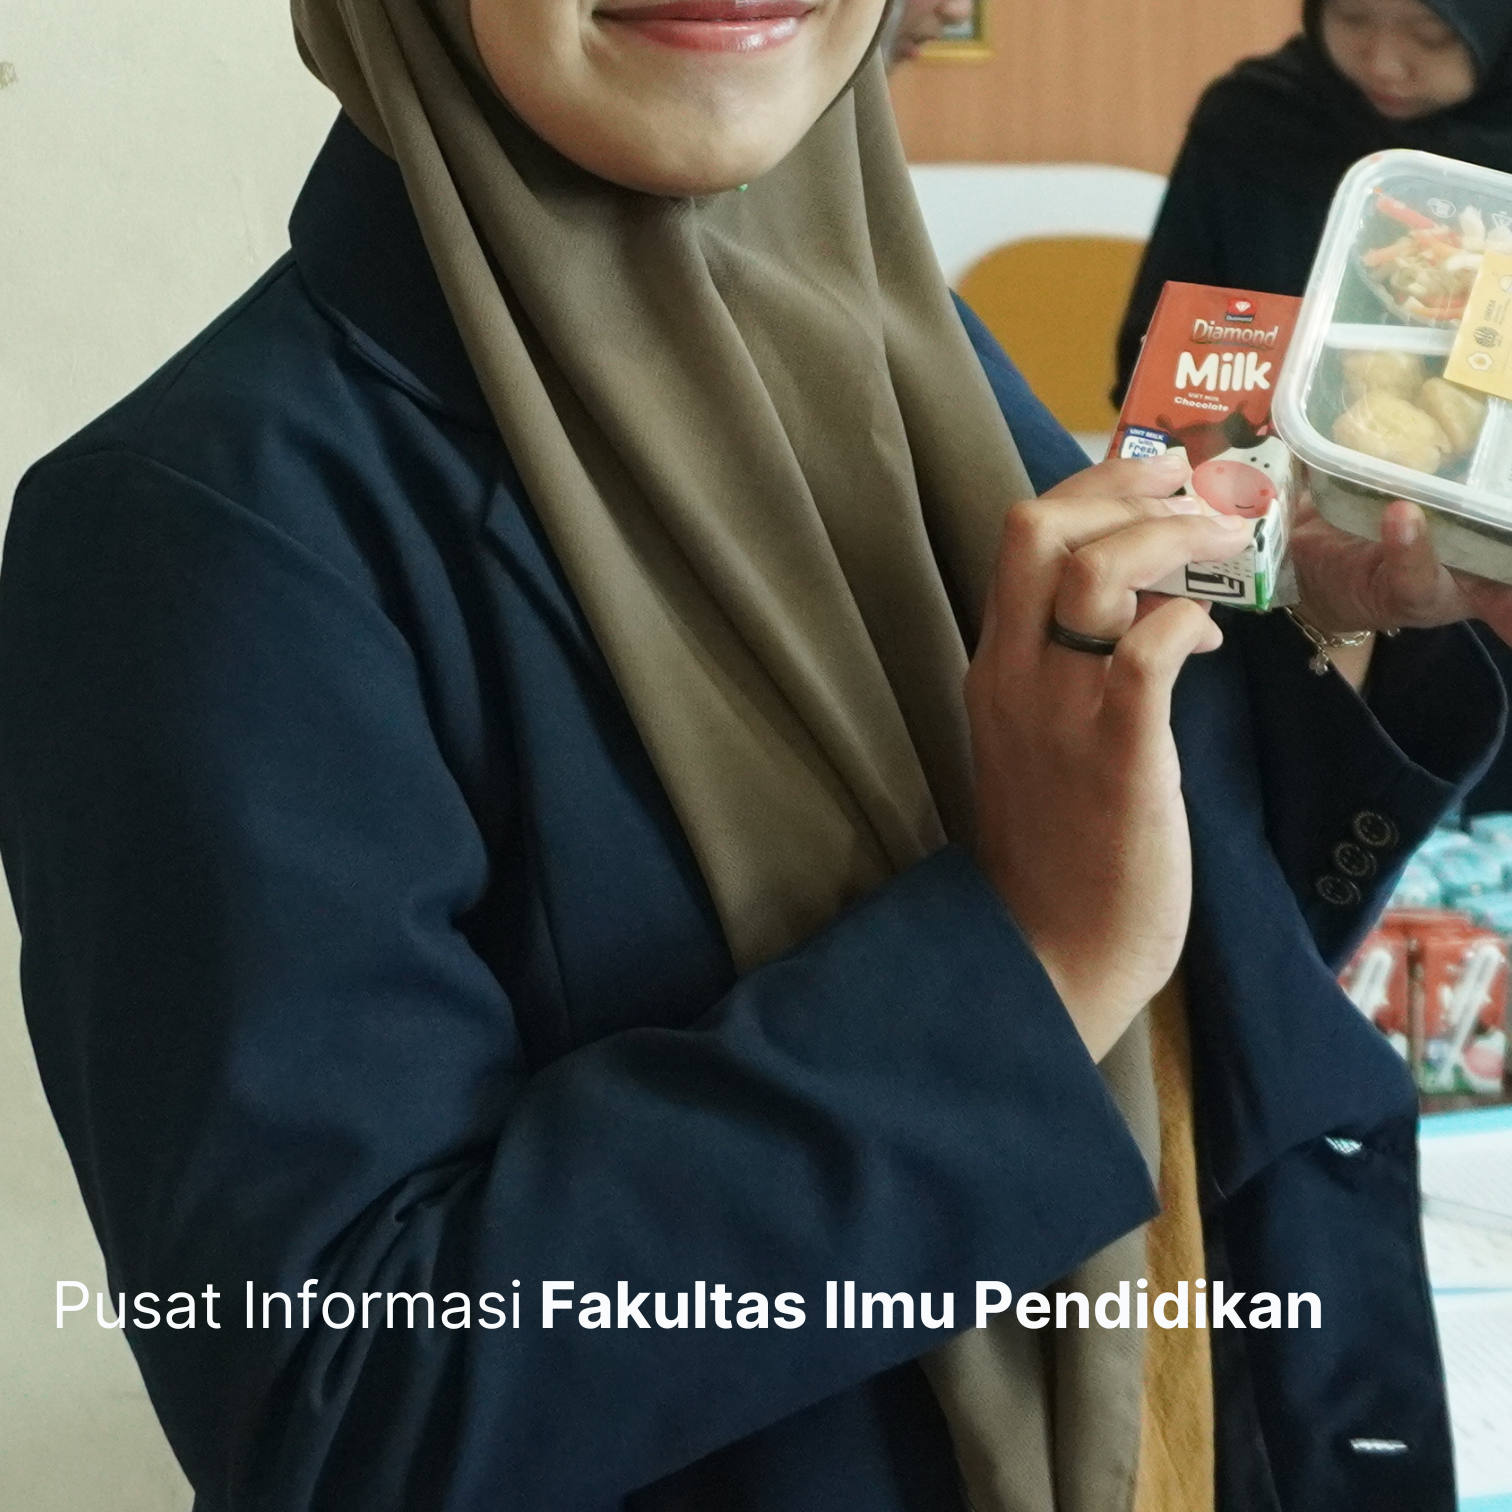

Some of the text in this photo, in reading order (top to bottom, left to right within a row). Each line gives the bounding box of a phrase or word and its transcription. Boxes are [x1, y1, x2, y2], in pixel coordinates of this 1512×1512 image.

[1192, 318, 1279, 346] Diamond
[1175, 351, 1272, 391] Milk
[1174, 396, 1229, 412] Chocolate
[1128, 441, 1159, 456] Fresh
